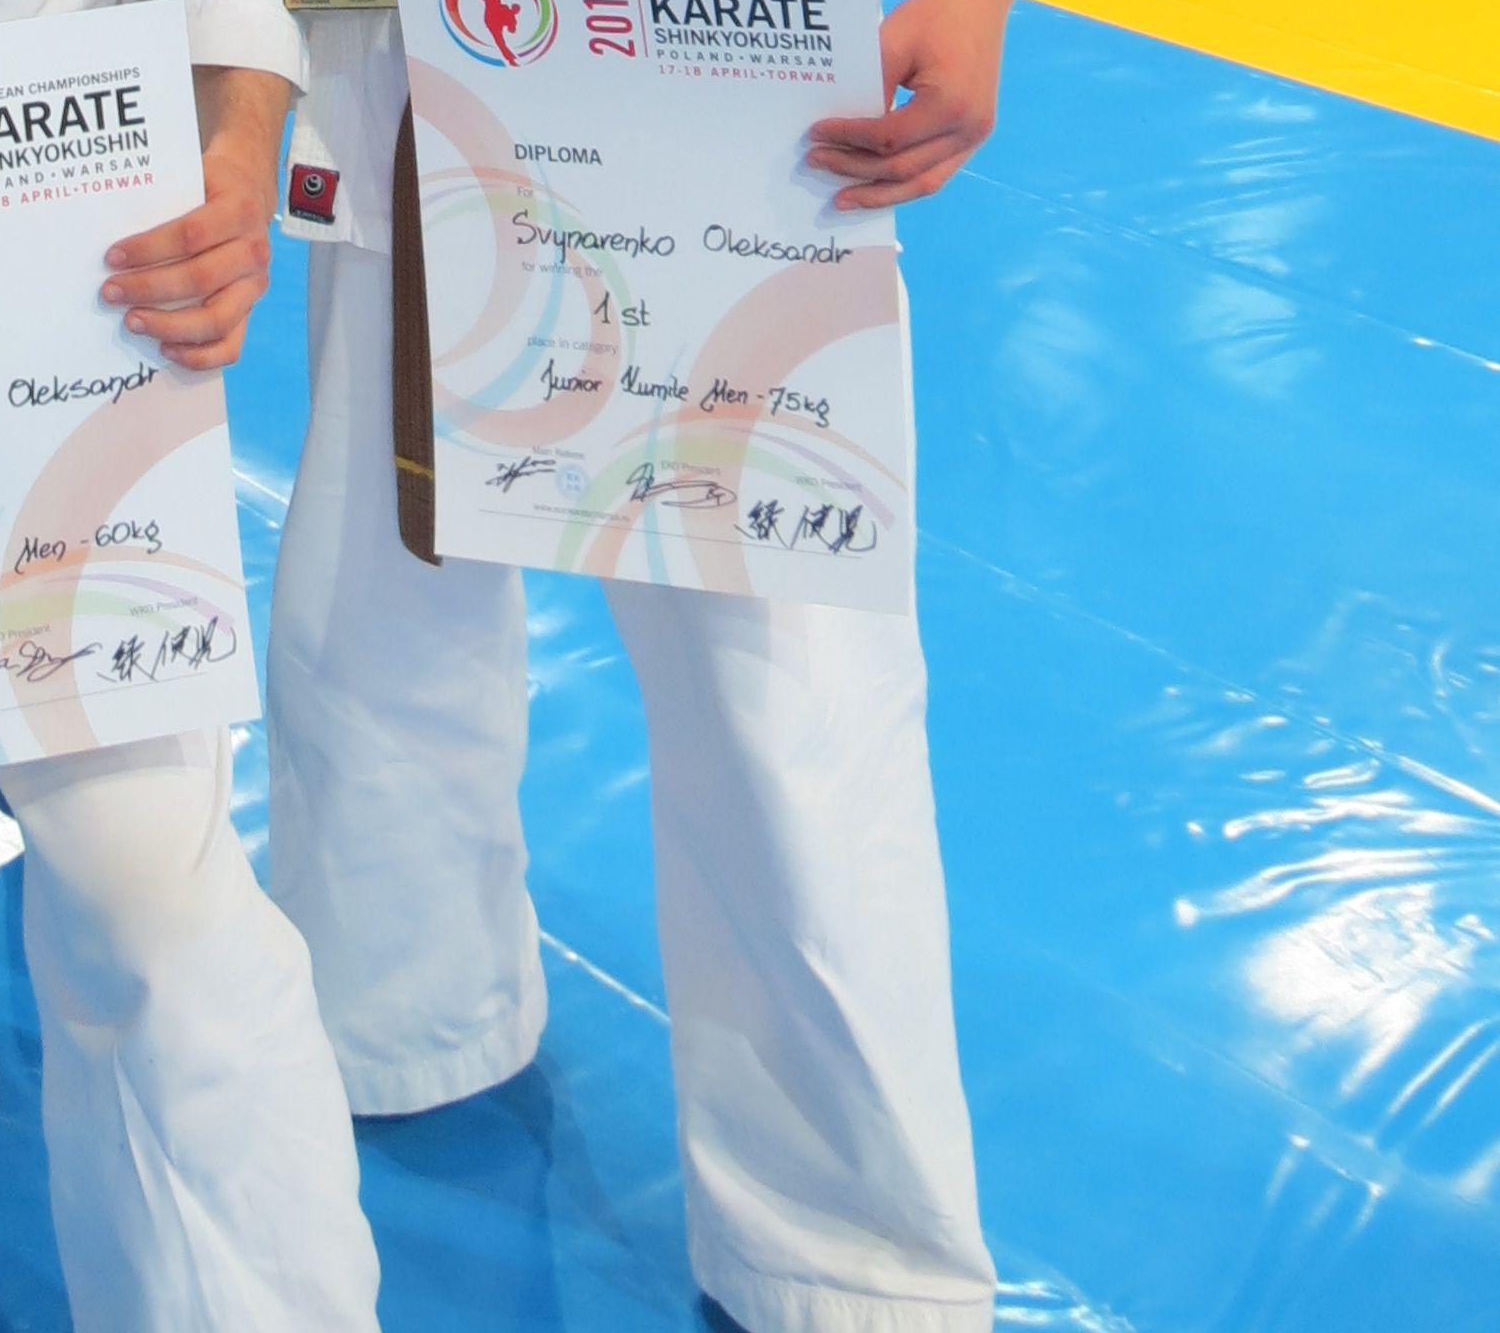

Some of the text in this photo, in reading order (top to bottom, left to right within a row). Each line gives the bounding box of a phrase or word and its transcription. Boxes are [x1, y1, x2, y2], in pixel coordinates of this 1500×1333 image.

[654, 27, 832, 52] SHINKYOKUSHIN
[28, 67, 141, 94] CHAMPIONSHIPS
[659, 64, 702, 77] 17-18
[514, 144, 603, 166] DIPLOMA
[517, 186, 534, 199] For
[512, 210, 854, 264] Svynarenko Oleksandr
[522, 260, 536, 272] for
[585, 263, 604, 277] the
[527, 335, 618, 355] place in category
[8, 361, 159, 407] Oleksandr
[620, 365, 690, 402] Kumite
[699, 378, 749, 412] Men
[14, 536, 66, 575] Men
